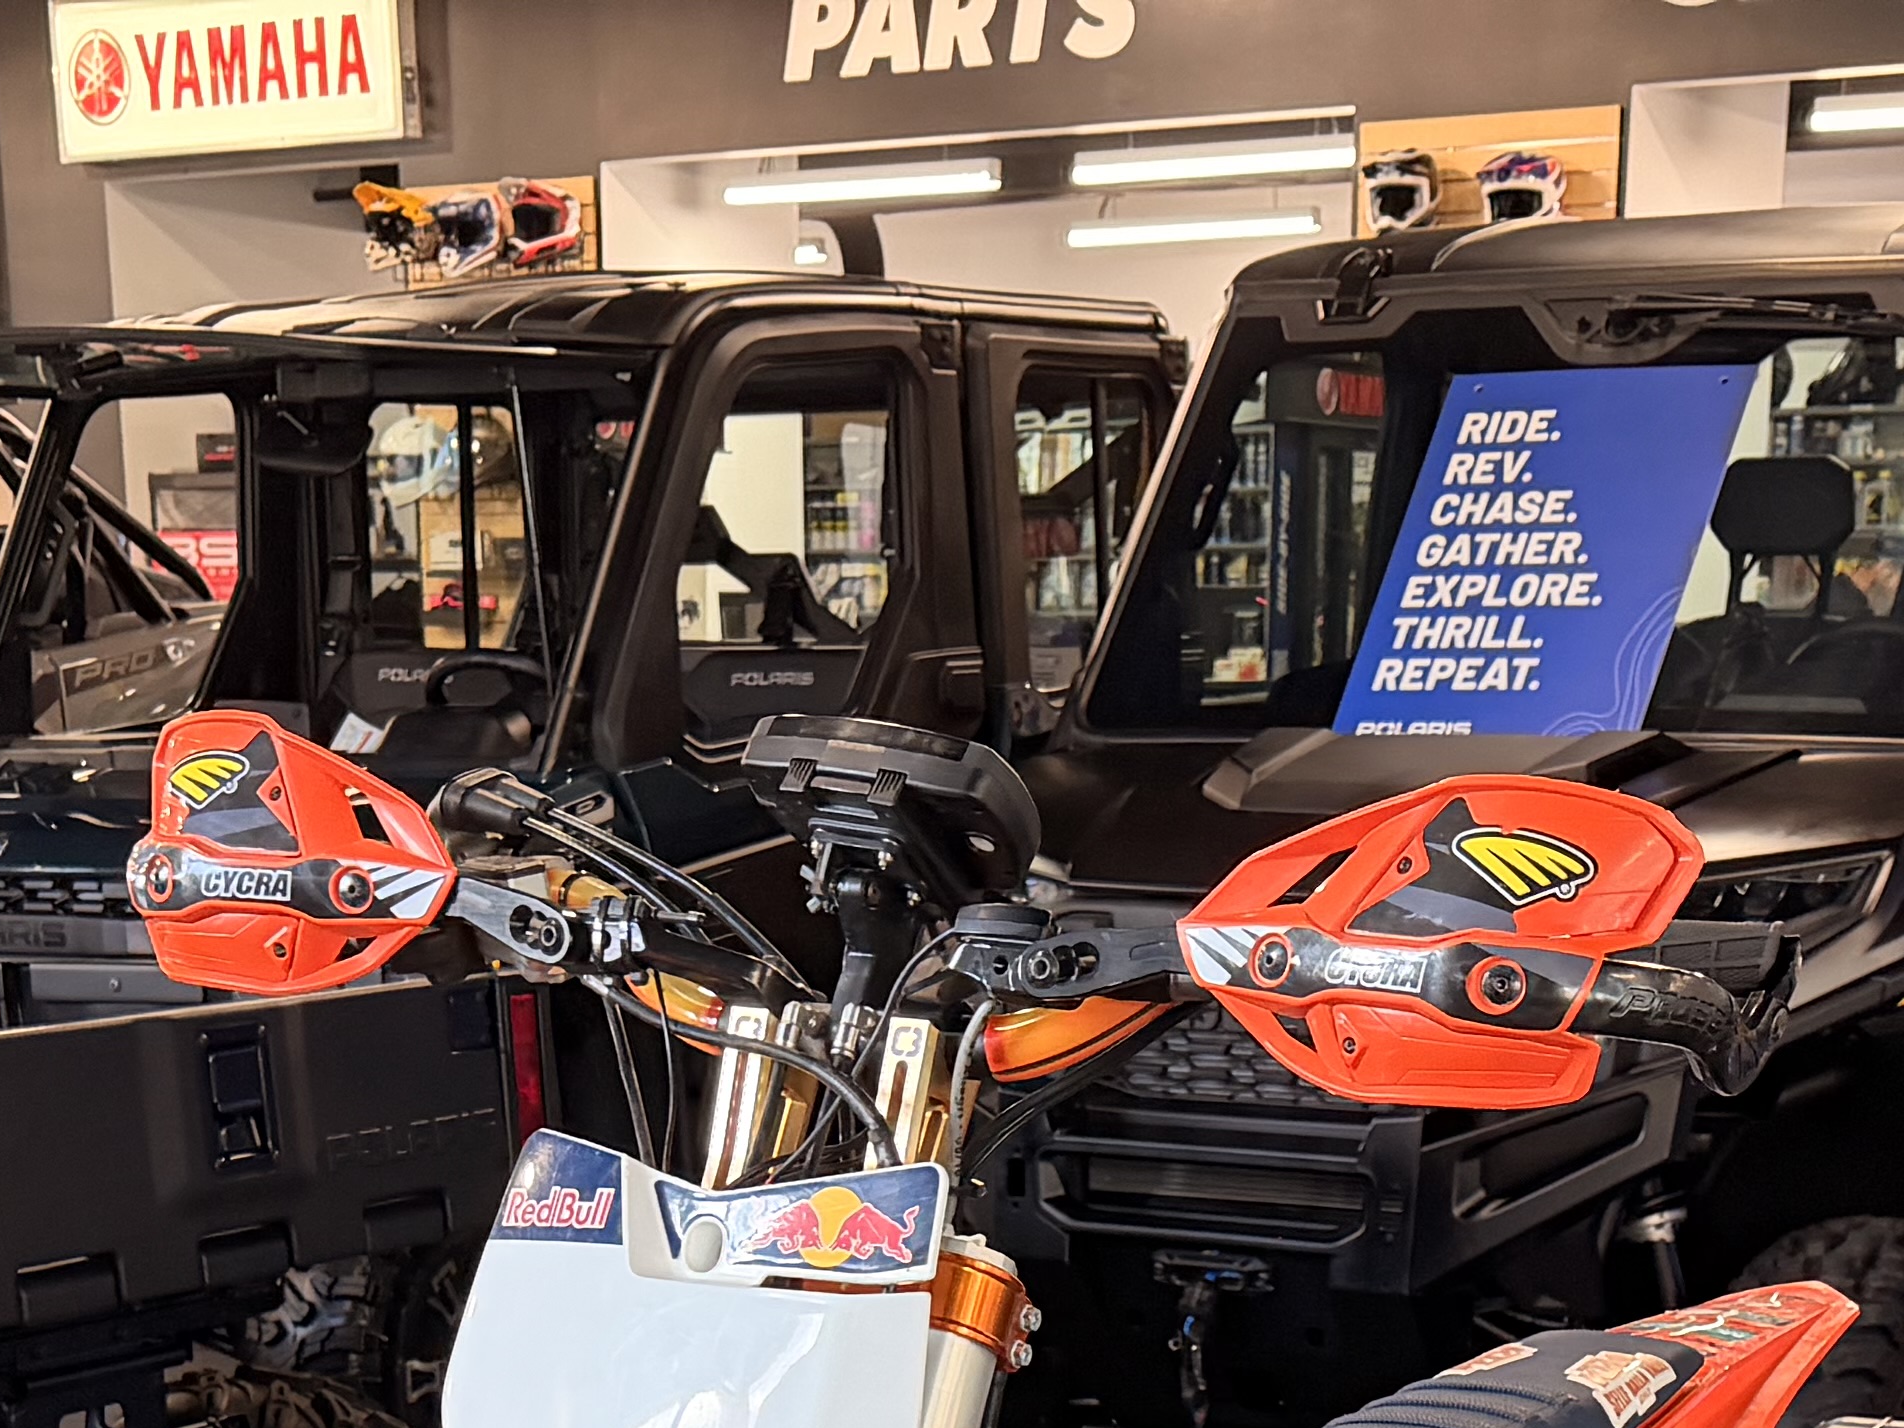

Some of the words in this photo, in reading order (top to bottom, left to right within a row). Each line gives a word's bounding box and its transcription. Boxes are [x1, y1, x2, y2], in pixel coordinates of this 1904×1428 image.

[782, 0, 1139, 84] PARTS
[134, 14, 371, 112] YAMAHA
[1457, 410, 1562, 445] RIDE.
[1442, 451, 1533, 486] REV.
[1429, 490, 1578, 526] CHASE.
[1416, 532, 1589, 569] GATHER.
[1399, 574, 1604, 609] EXPLORE.
[1391, 617, 1545, 651] THRILL.
[75, 651, 156, 688] PRO
[730, 672, 815, 687] POLARIS
[1370, 657, 1541, 692] REPEAT.
[1354, 721, 1472, 737] POLARIS
[200, 867, 291, 902] CYCRA
